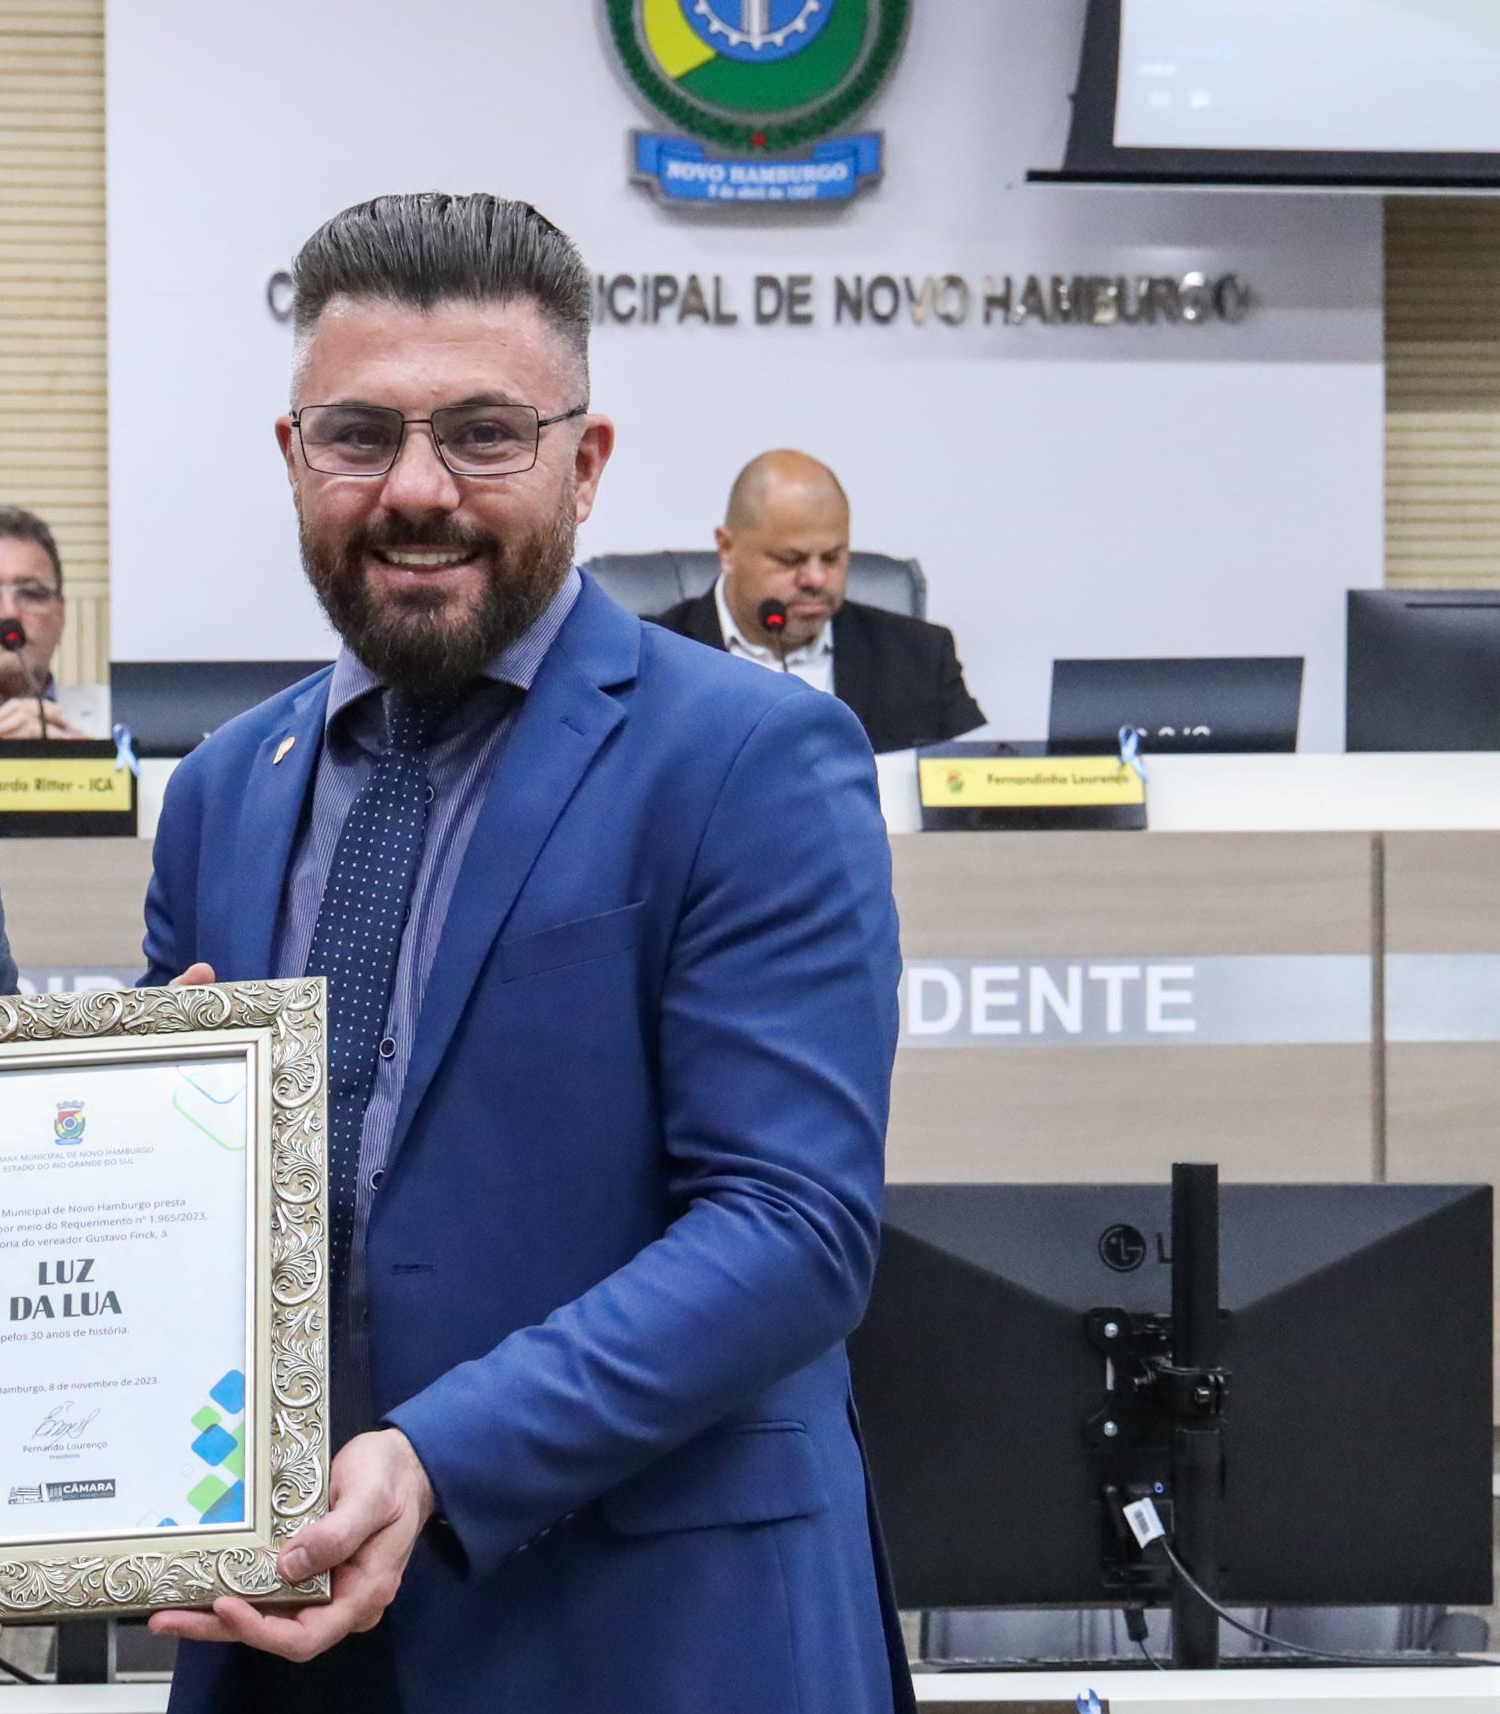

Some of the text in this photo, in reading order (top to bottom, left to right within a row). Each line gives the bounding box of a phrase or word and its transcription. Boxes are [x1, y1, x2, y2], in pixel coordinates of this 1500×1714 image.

[667, 160, 849, 184] NOVO HAMBURGO
[596, 273, 737, 325] ICIPAL
[754, 273, 813, 325] DE
[834, 273, 968, 325] NOVO
[907, 964, 1197, 1035] DENTE
[20, 1152, 64, 1162] MUNICIPAL
[66, 1151, 78, 1159] DE
[79, 1149, 104, 1158] NOVO
[105, 1146, 154, 1156] HAMBURGO
[3, 1157, 134, 1172] ESTADO DO RIO GRANDE DO SUL
[1, 1206, 50, 1218] Municipal
[52, 1206, 65, 1215] de
[68, 1204, 94, 1213] Novo
[98, 1201, 151, 1211] Hamburgo
[153, 1199, 186, 1209] presta
[17, 1222, 42, 1232] meio
[45, 1221, 58, 1230] do
[61, 1216, 133, 1230] Requerimento
[22, 1238, 35, 1247] do
[37, 1235, 82, 1246] vereador
[86, 1233, 127, 1243] Gustavo
[130, 1230, 158, 1240] Finck,
[1156, 1231, 1173, 1264] L
[38, 1258, 95, 1285] LUZ
[9, 1290, 122, 1321] DA LUA
[1, 1325, 129, 1344] pelos 30 anos de história.
[48, 1383, 55, 1391] 8
[57, 1382, 69, 1390] de
[71, 1379, 118, 1389] novembro
[120, 1378, 132, 1387] de
[134, 1376, 159, 1386] 2023.
[23, 1440, 107, 1453] Fernando Lourenço
[63, 1482, 113, 1493] CÂMARA
